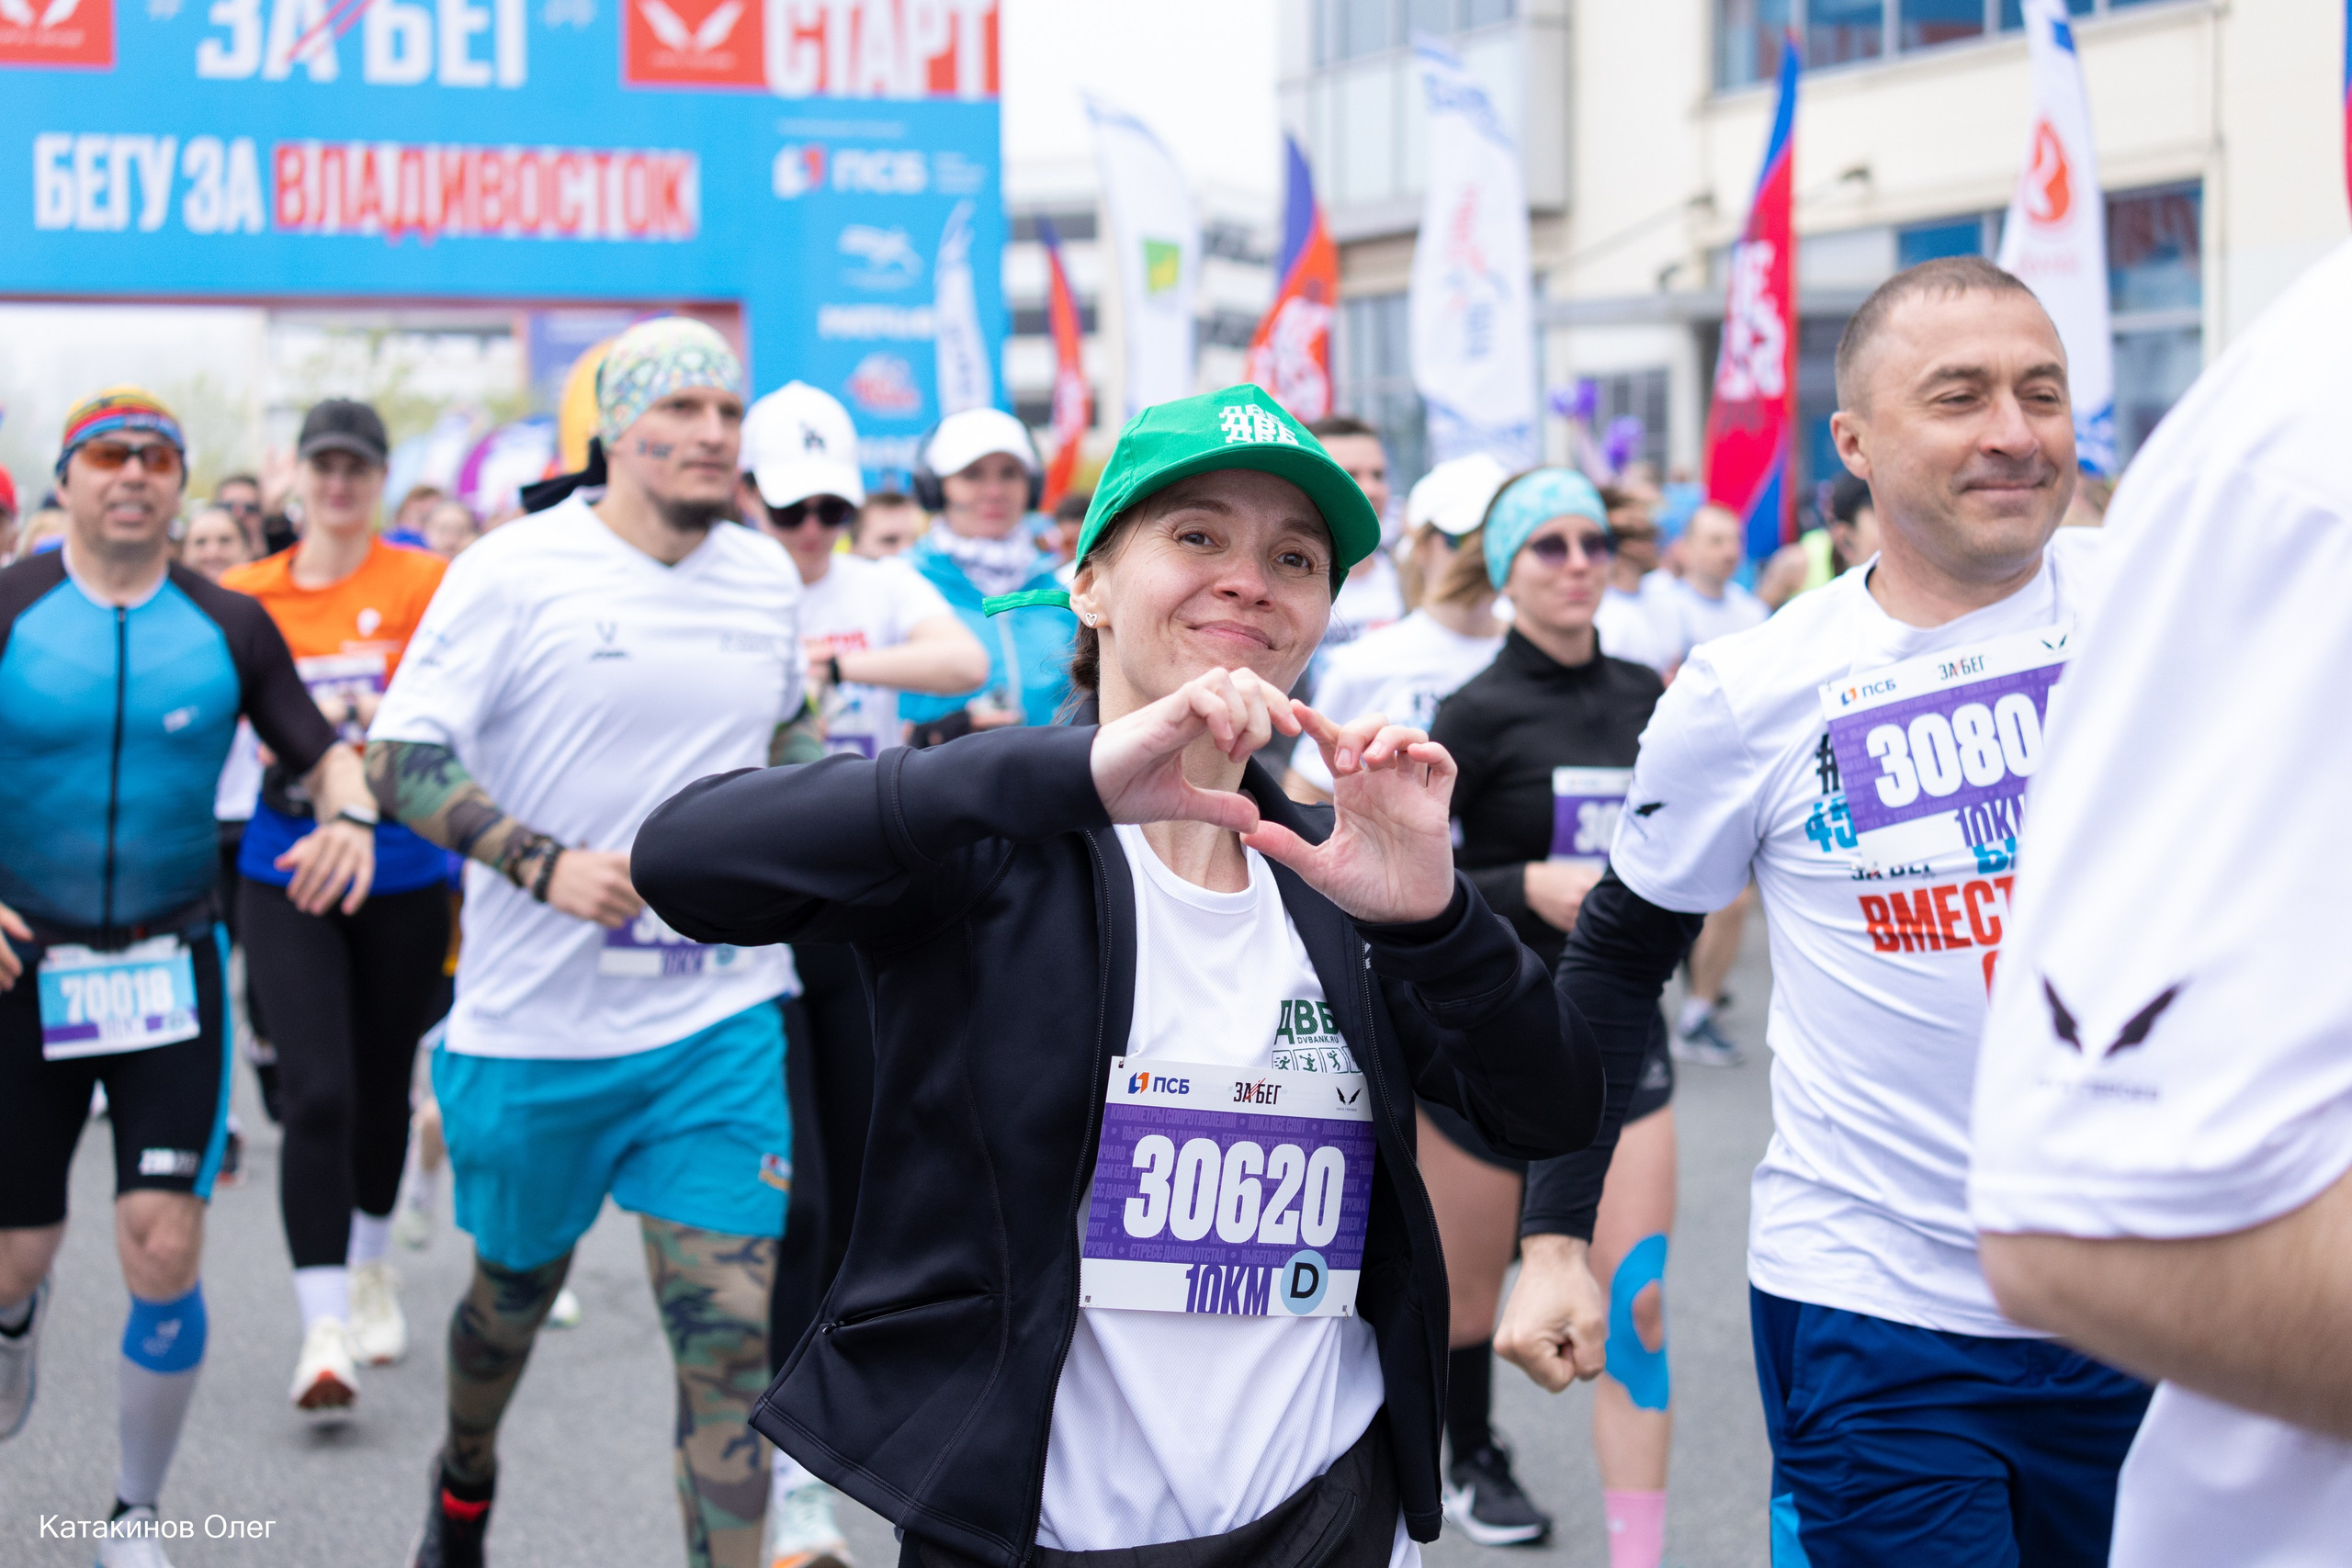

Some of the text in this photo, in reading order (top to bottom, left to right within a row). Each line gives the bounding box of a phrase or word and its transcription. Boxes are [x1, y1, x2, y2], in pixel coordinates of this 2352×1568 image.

[34, 133, 698, 246] БЕГУ ЗА ВЛАДИВОСТОК
[1861, 678, 1896, 698] ПСБ
[1865, 683, 2064, 807] 3080
[61, 967, 173, 1023] 70018
[1153, 1077, 1190, 1095] ПСБ
[1248, 1115, 1269, 1131] ПОКА
[1270, 1117, 1284, 1133] ВСЕ
[1286, 1118, 1306, 1134] СПЯТ
[1124, 1134, 1345, 1247] 30620
[1129, 1244, 1163, 1259] СТРЕСС
[1163, 1247, 1193, 1262] ДАВНО
[1193, 1247, 1226, 1263] ОТСТАЛ
[1241, 1249, 1280, 1265] ВЫБЕГАЮ
[1290, 1261, 1318, 1299] D
